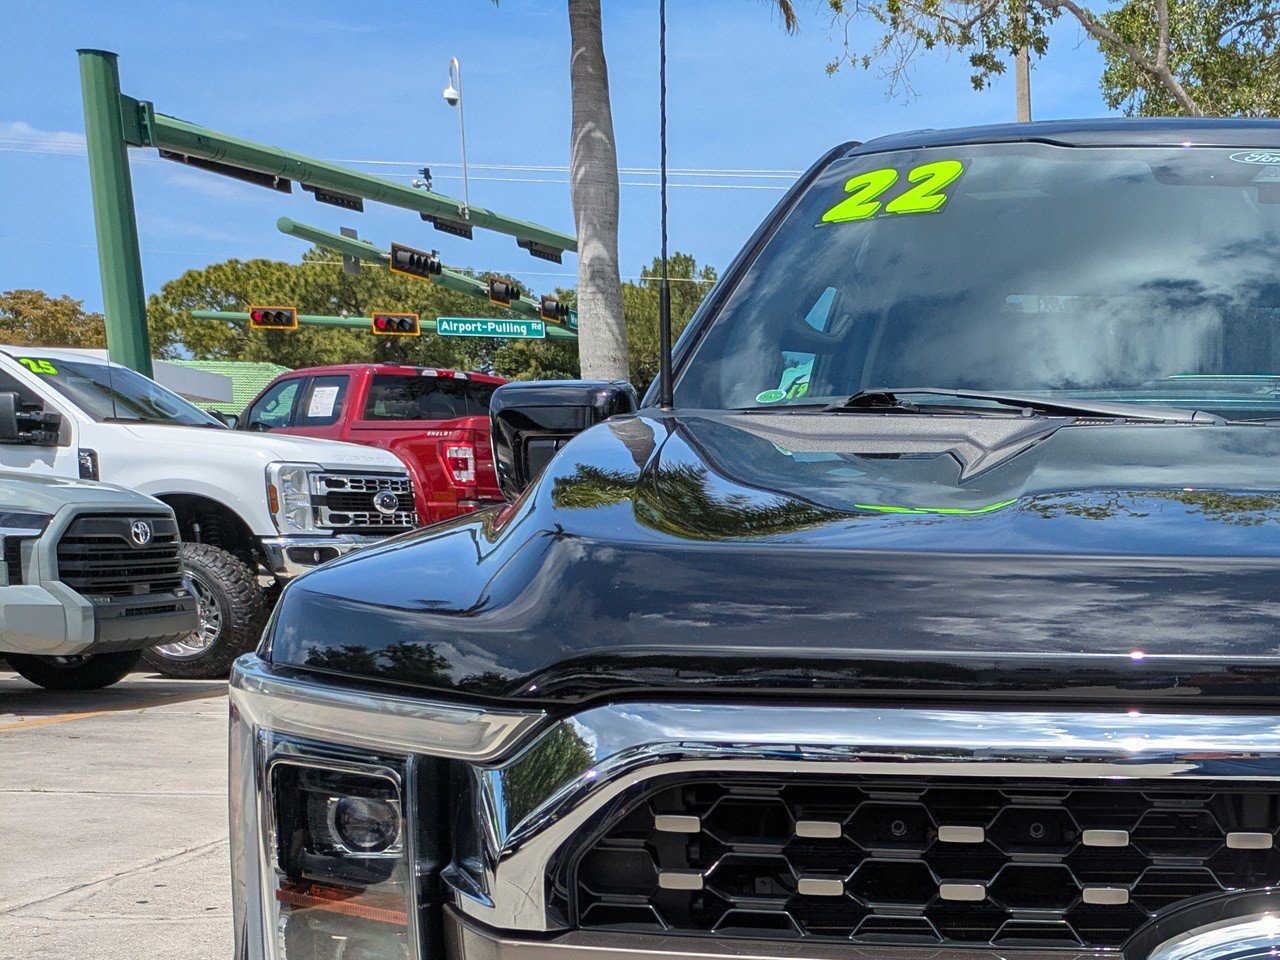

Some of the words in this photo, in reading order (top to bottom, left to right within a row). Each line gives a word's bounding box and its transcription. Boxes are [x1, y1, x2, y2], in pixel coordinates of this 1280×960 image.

[822, 160, 963, 223] 22
[441, 320, 528, 335] Airport-Pulling
[531, 322, 542, 331] Rd
[19, 358, 58, 376] 25
